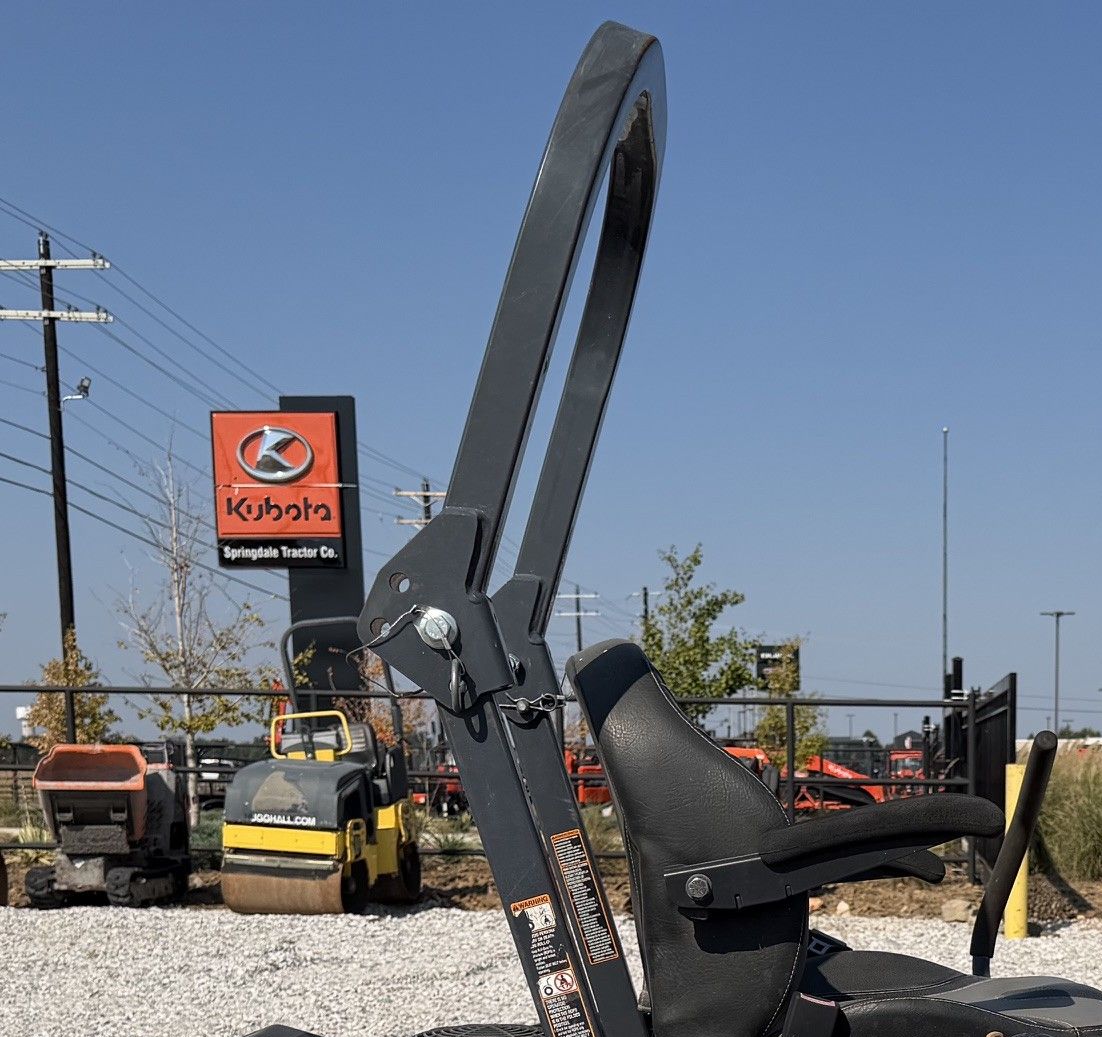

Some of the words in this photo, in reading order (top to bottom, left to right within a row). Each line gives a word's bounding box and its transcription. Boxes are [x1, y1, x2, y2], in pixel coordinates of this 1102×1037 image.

[226, 497, 332, 522] Kubota
[223, 545, 280, 561] Springdale
[281, 546, 318, 559] Tractor
[320, 546, 338, 559] Co.
[520, 896, 549, 909] WARNING
